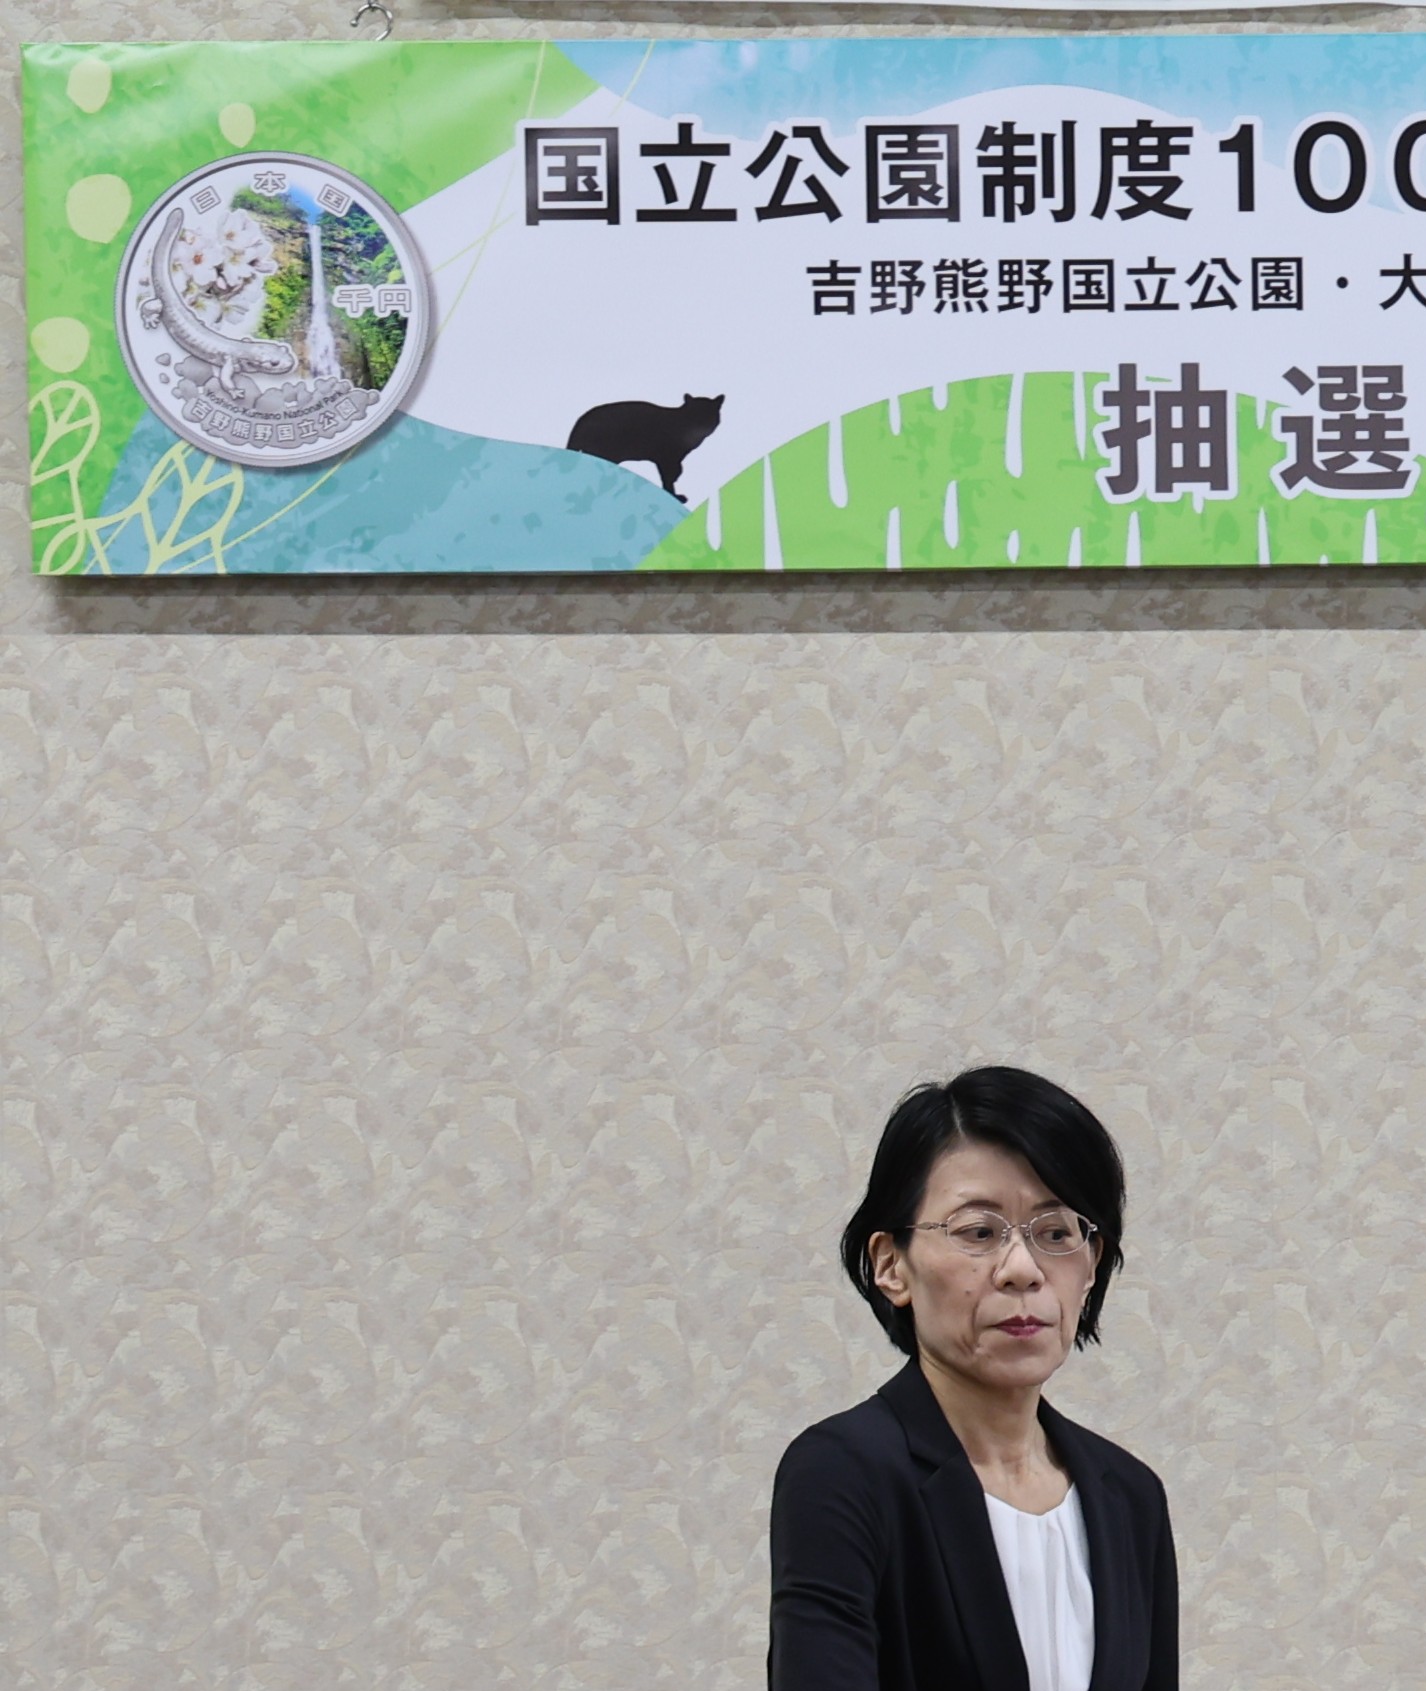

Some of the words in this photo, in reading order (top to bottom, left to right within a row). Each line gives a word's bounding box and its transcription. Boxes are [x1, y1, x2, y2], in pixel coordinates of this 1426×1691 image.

[190, 170, 351, 215] 日本国
[335, 287, 412, 314] 千円
[206, 389, 281, 421] Yoshino-Kumano
[284, 401, 324, 420] National
[324, 391, 345, 408] Park
